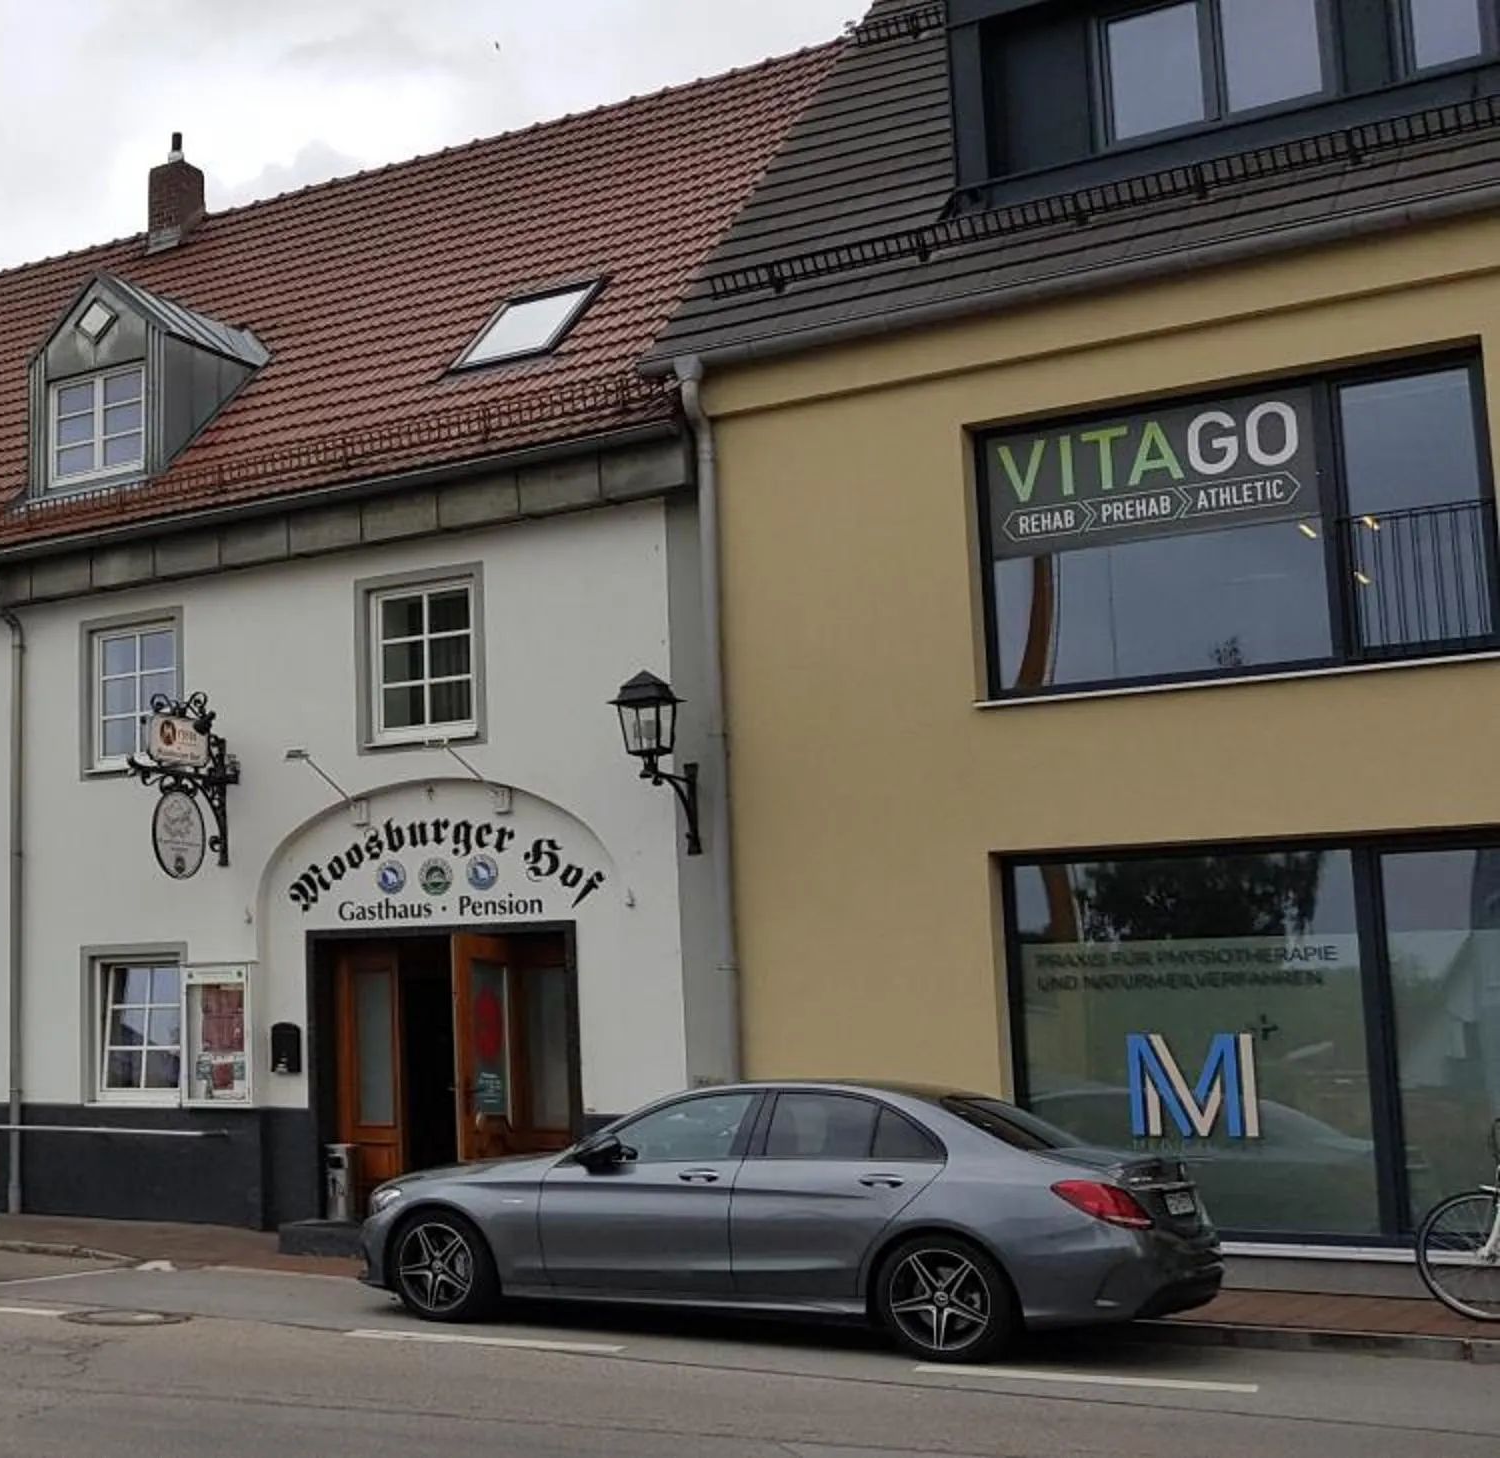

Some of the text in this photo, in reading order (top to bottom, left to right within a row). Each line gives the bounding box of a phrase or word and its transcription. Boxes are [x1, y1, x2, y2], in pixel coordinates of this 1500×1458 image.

[997, 401, 1299, 502] VITAGO
[1197, 479, 1285, 511] ATHLETIC
[1018, 509, 1076, 535] REHAB
[1101, 495, 1172, 524] PREHAB
[289, 817, 516, 912] Moosburger
[523, 838, 605, 909] Hof
[338, 894, 544, 921] Gasthaus Pension
[1156, 945, 1339, 966] PHYSIOTHERAPIE
[1037, 974, 1078, 991] UND
